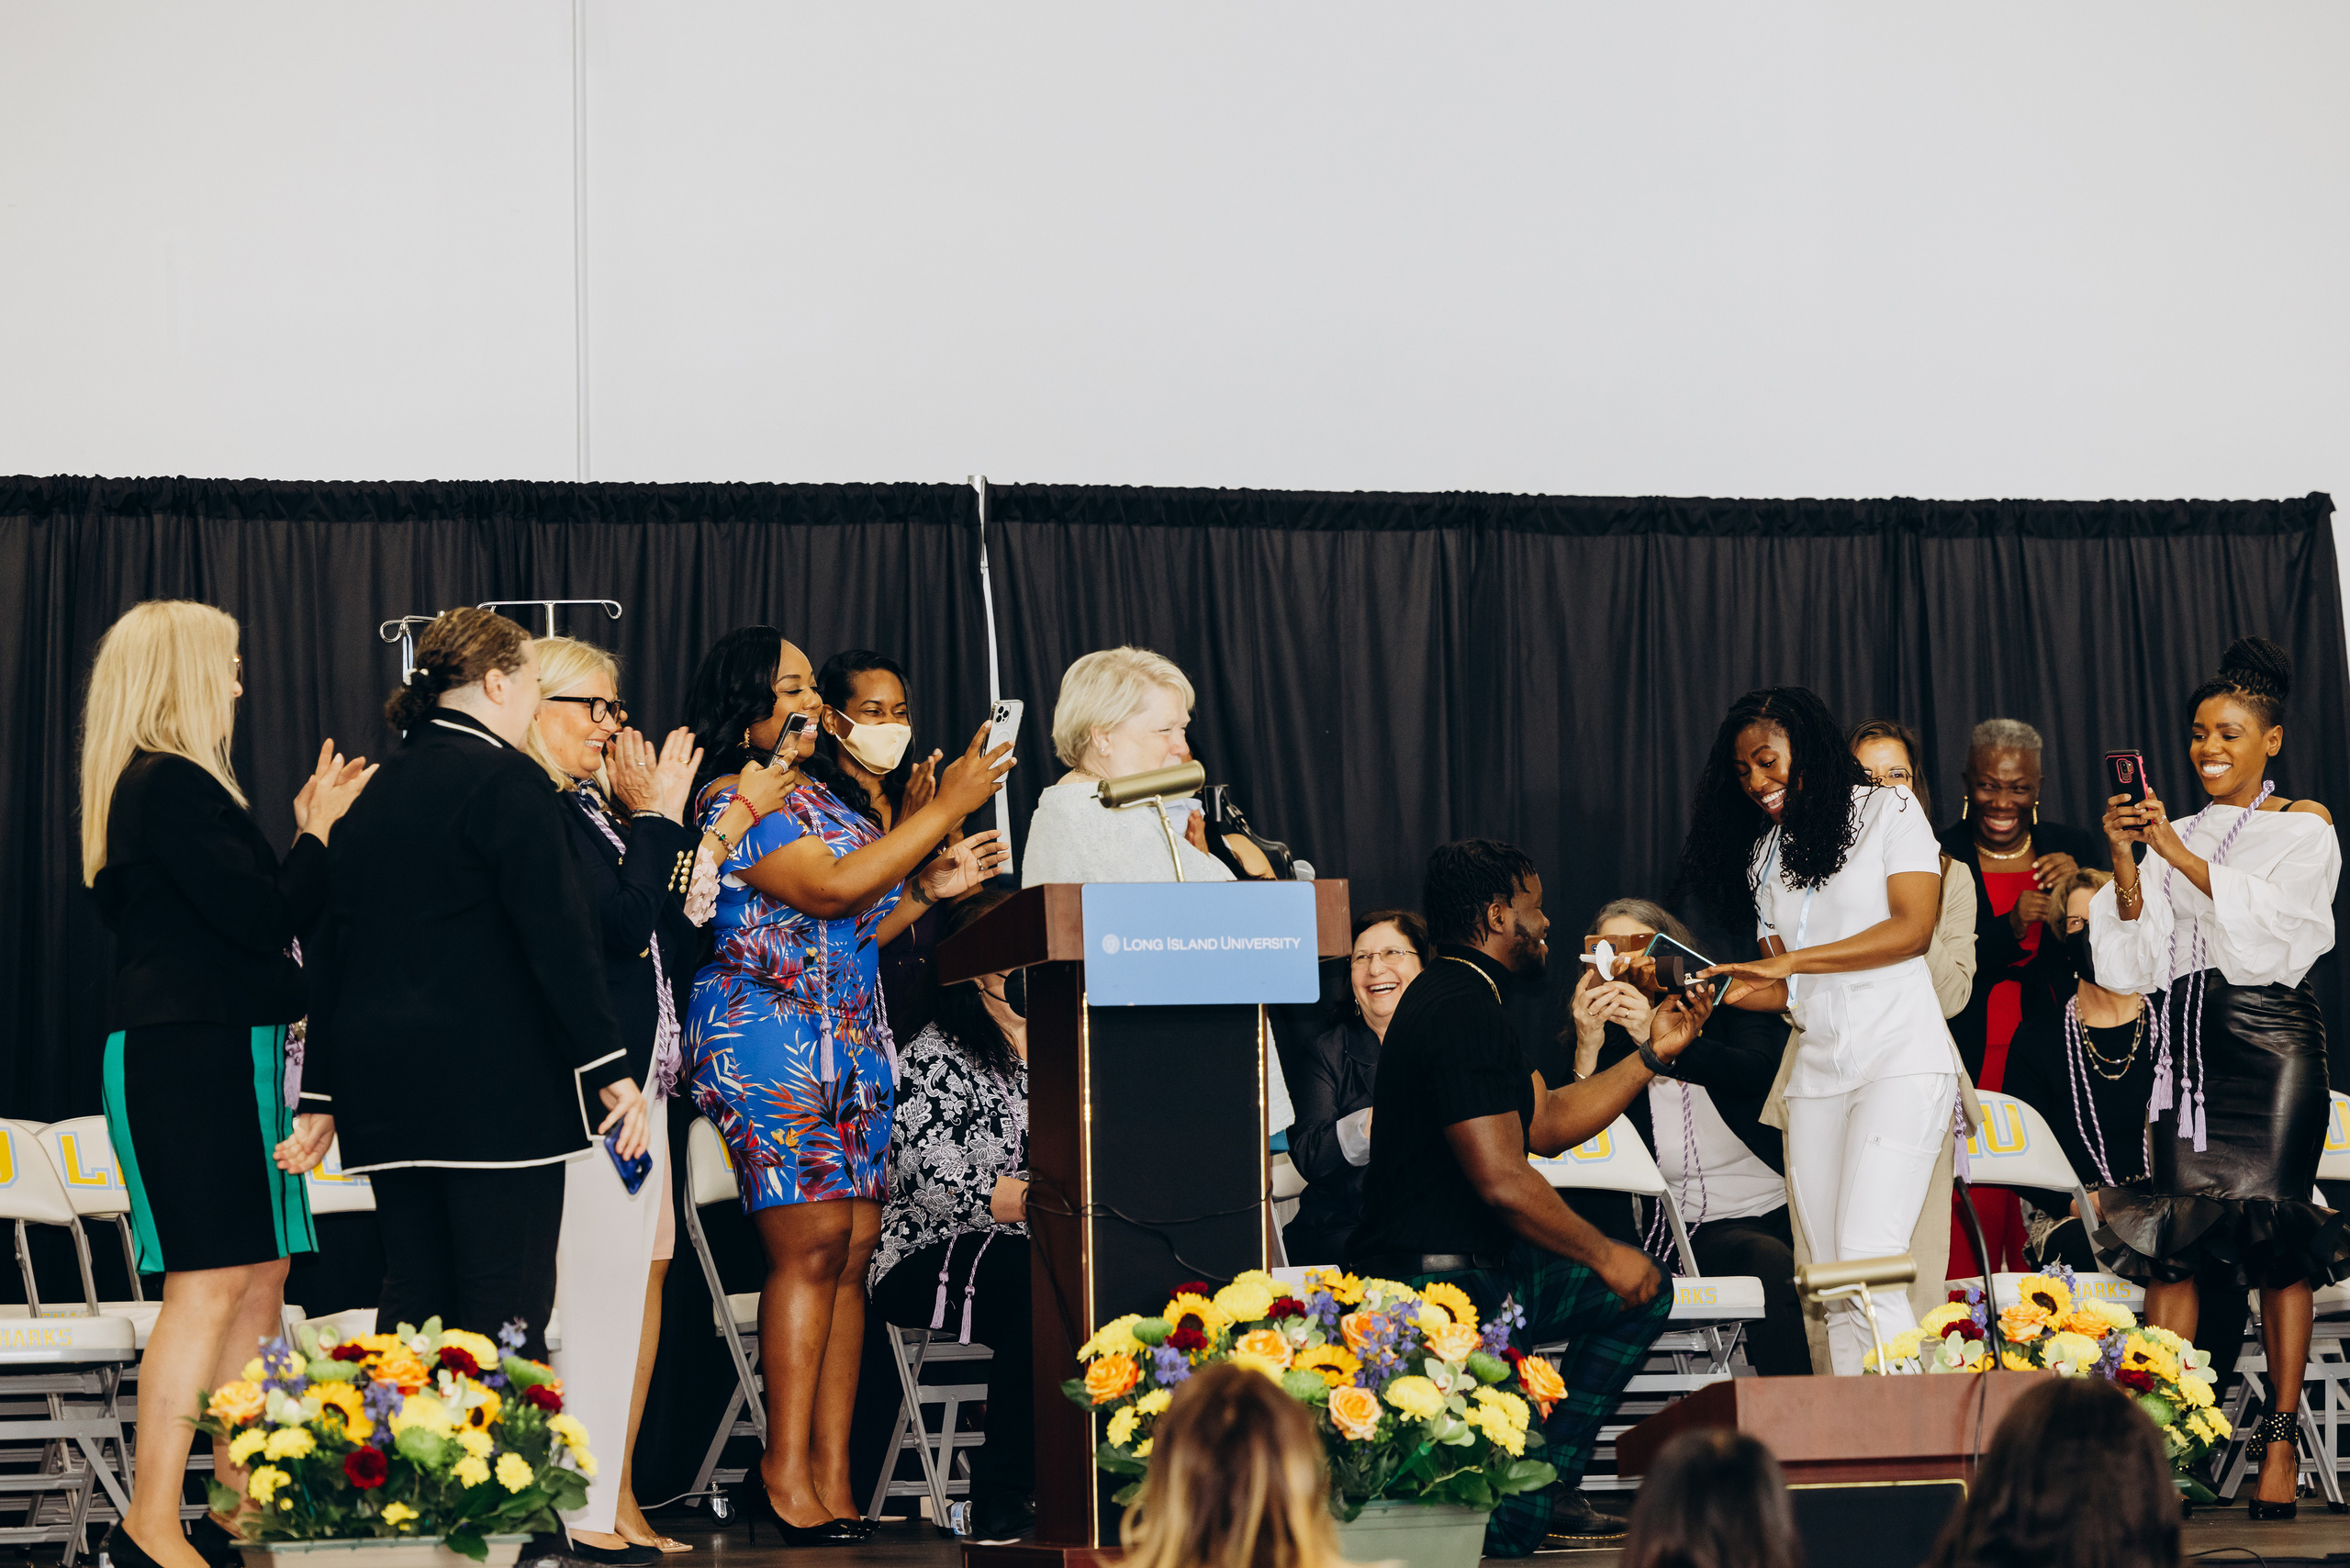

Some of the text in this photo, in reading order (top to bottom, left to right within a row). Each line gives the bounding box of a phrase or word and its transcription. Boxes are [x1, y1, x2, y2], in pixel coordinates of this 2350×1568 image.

[1123, 935, 1301, 952] LONG ISLAND UNIVERSITY
